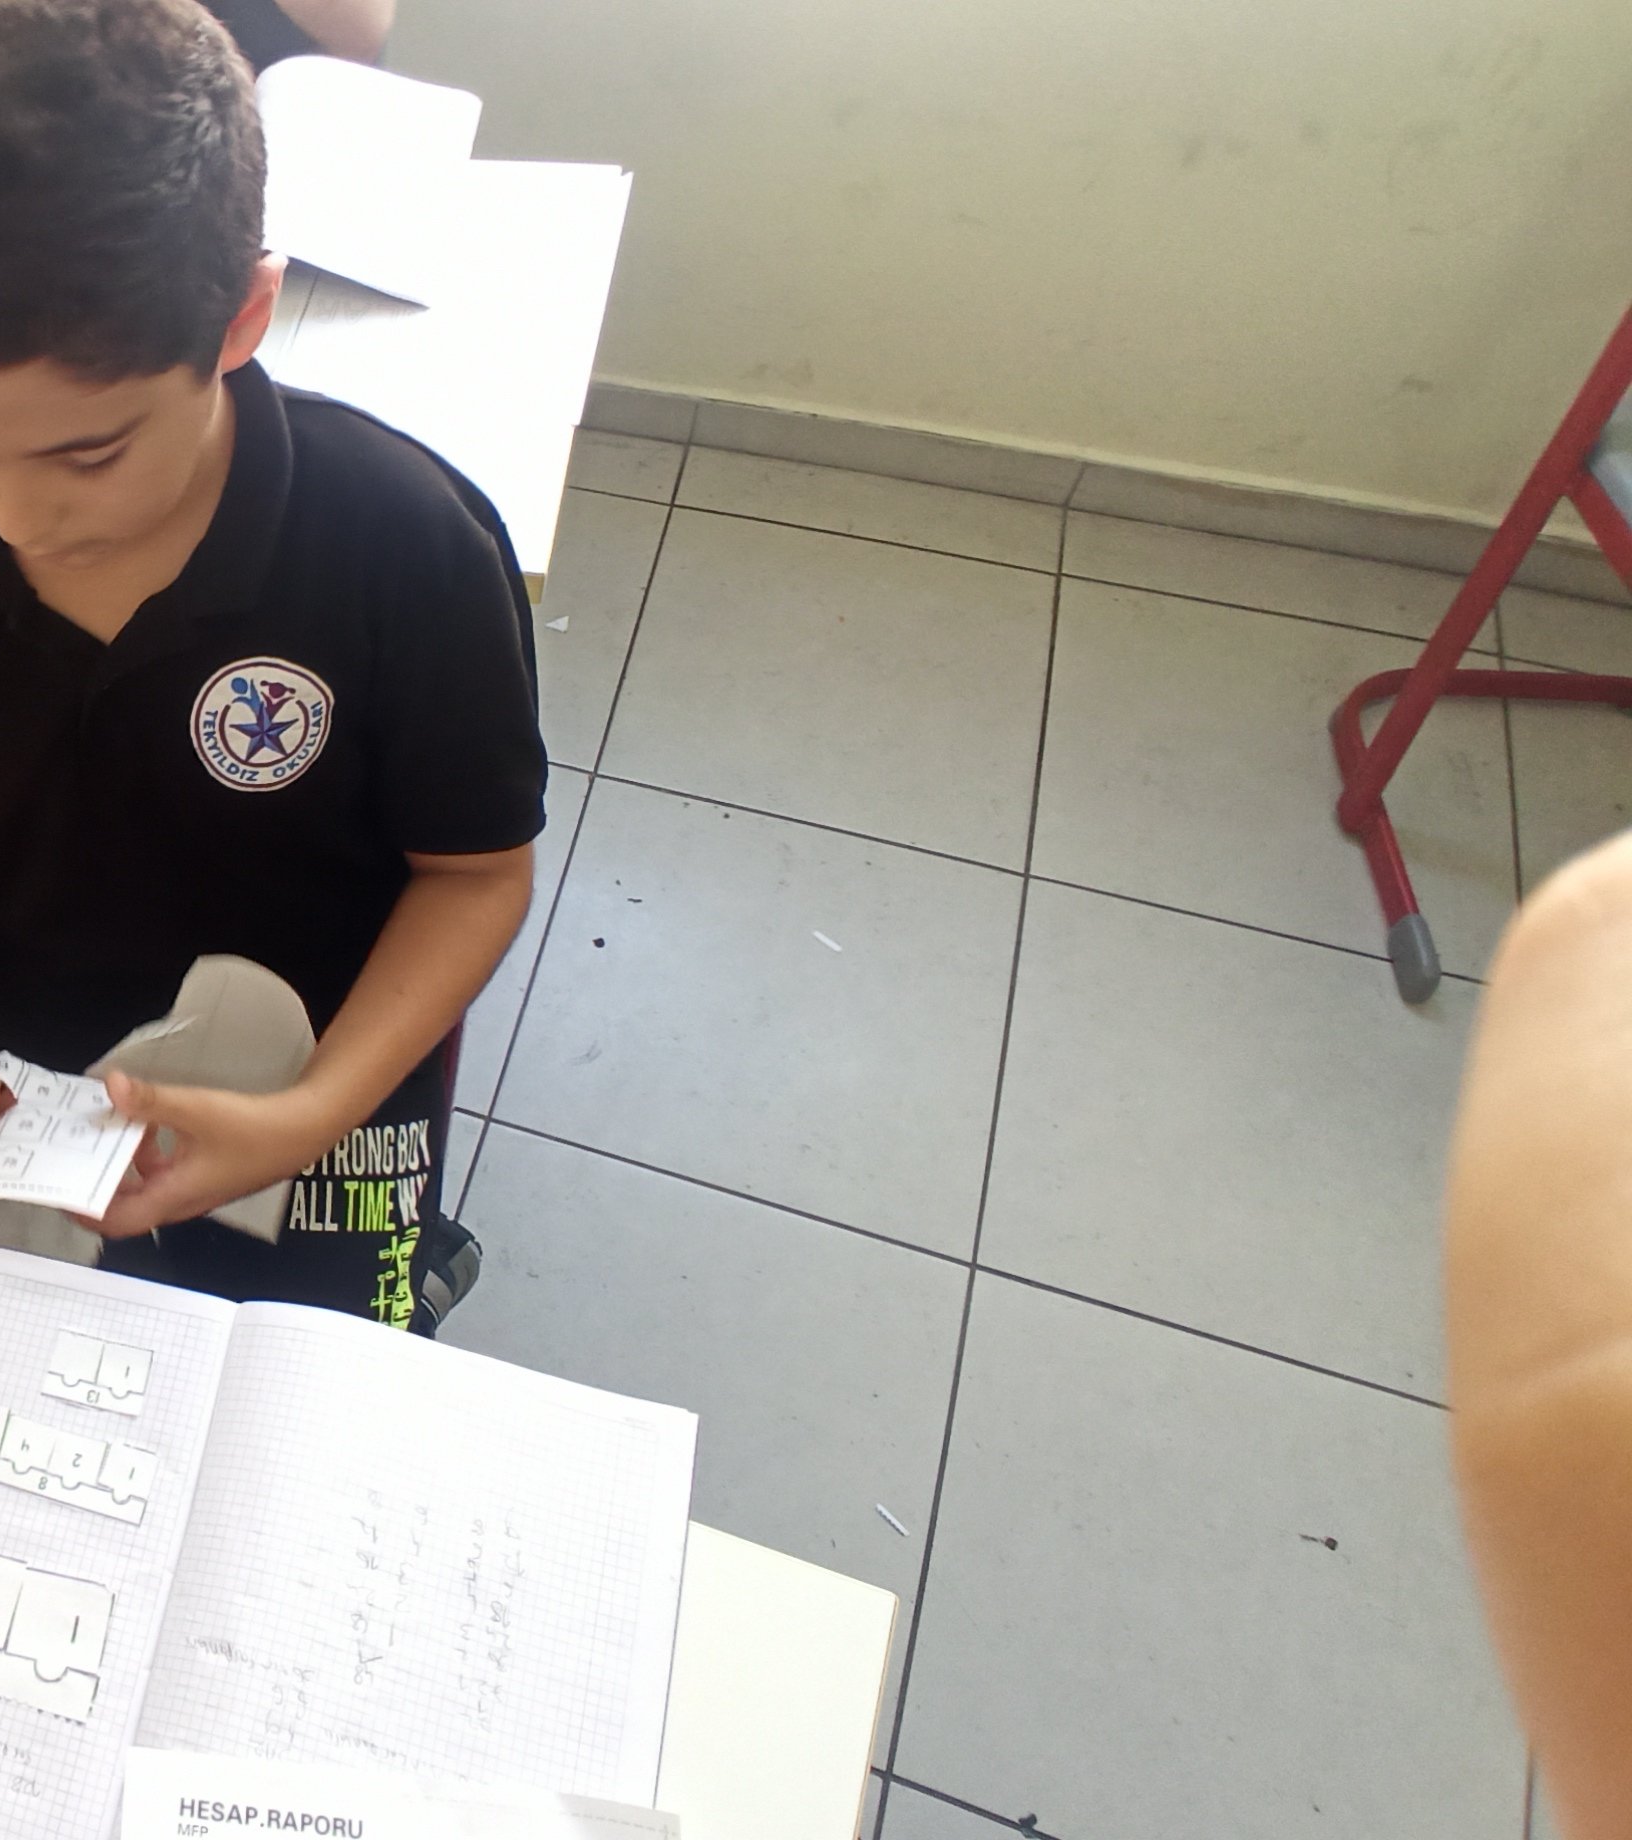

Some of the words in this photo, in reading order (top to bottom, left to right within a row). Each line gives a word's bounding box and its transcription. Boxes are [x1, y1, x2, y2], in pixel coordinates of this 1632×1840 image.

[203, 710, 260, 781] TEKYILDIZ
[397, 1118, 431, 1174] BOY
[289, 1181, 338, 1232] ALL
[344, 1181, 396, 1232] TIME
[177, 1823, 209, 1838] MFP
[178, 1797, 364, 1840] HESAP.RAPORU
